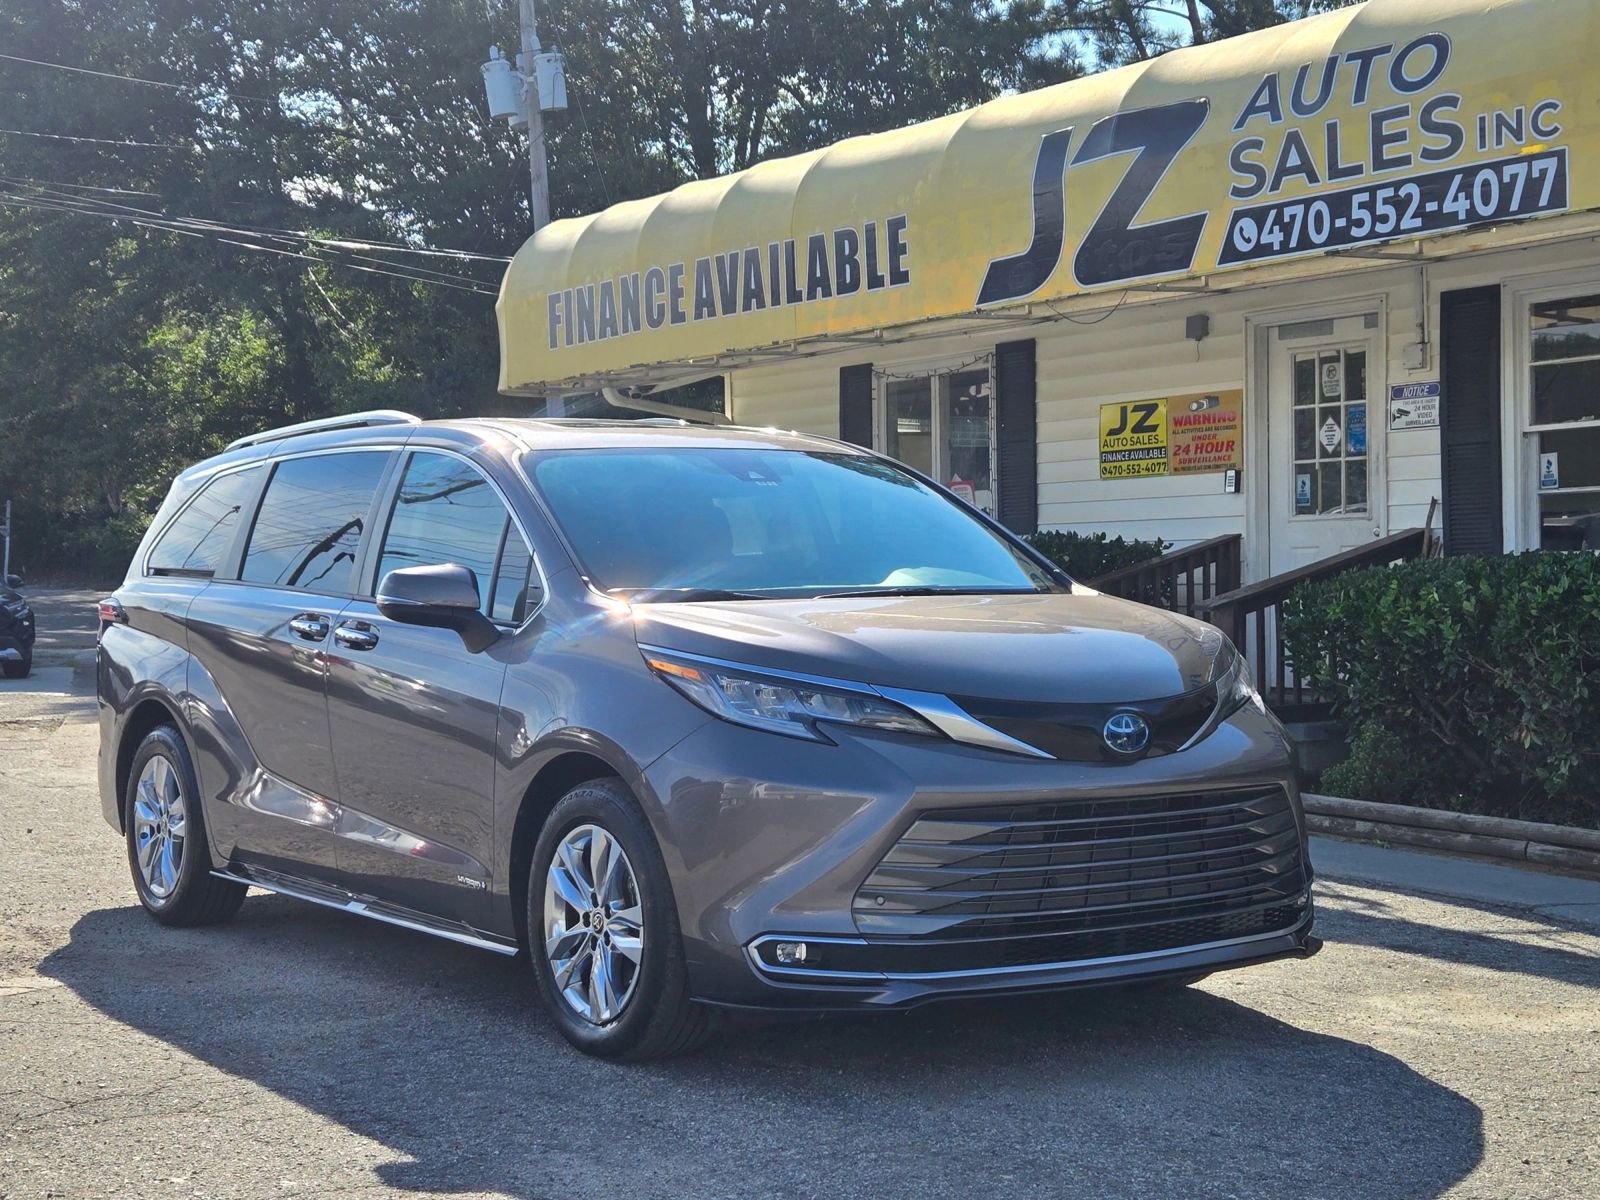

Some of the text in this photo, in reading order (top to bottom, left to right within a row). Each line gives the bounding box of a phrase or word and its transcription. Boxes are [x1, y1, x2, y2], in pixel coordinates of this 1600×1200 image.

[1231, 31, 1452, 132] AUTO
[1228, 93, 1562, 200] SALES INC
[975, 96, 1210, 306] JZ
[1259, 156, 1559, 252] 470-552-4077
[547, 213, 912, 351] FINANCE AVAILABLE
[1402, 386, 1429, 398] NOTICE
[1106, 403, 1160, 436] JZ
[1173, 412, 1236, 427] WARNING
[1102, 434, 1160, 449] AUTO SALES
[1191, 433, 1217, 441] UNDER
[1102, 448, 1166, 462] FINANCE AVAILABLE
[1172, 440, 1235, 457] 24 HOUR
[1178, 456, 1232, 464] SURVEILLANCE
[1107, 461, 1167, 476] 470-552-4077
